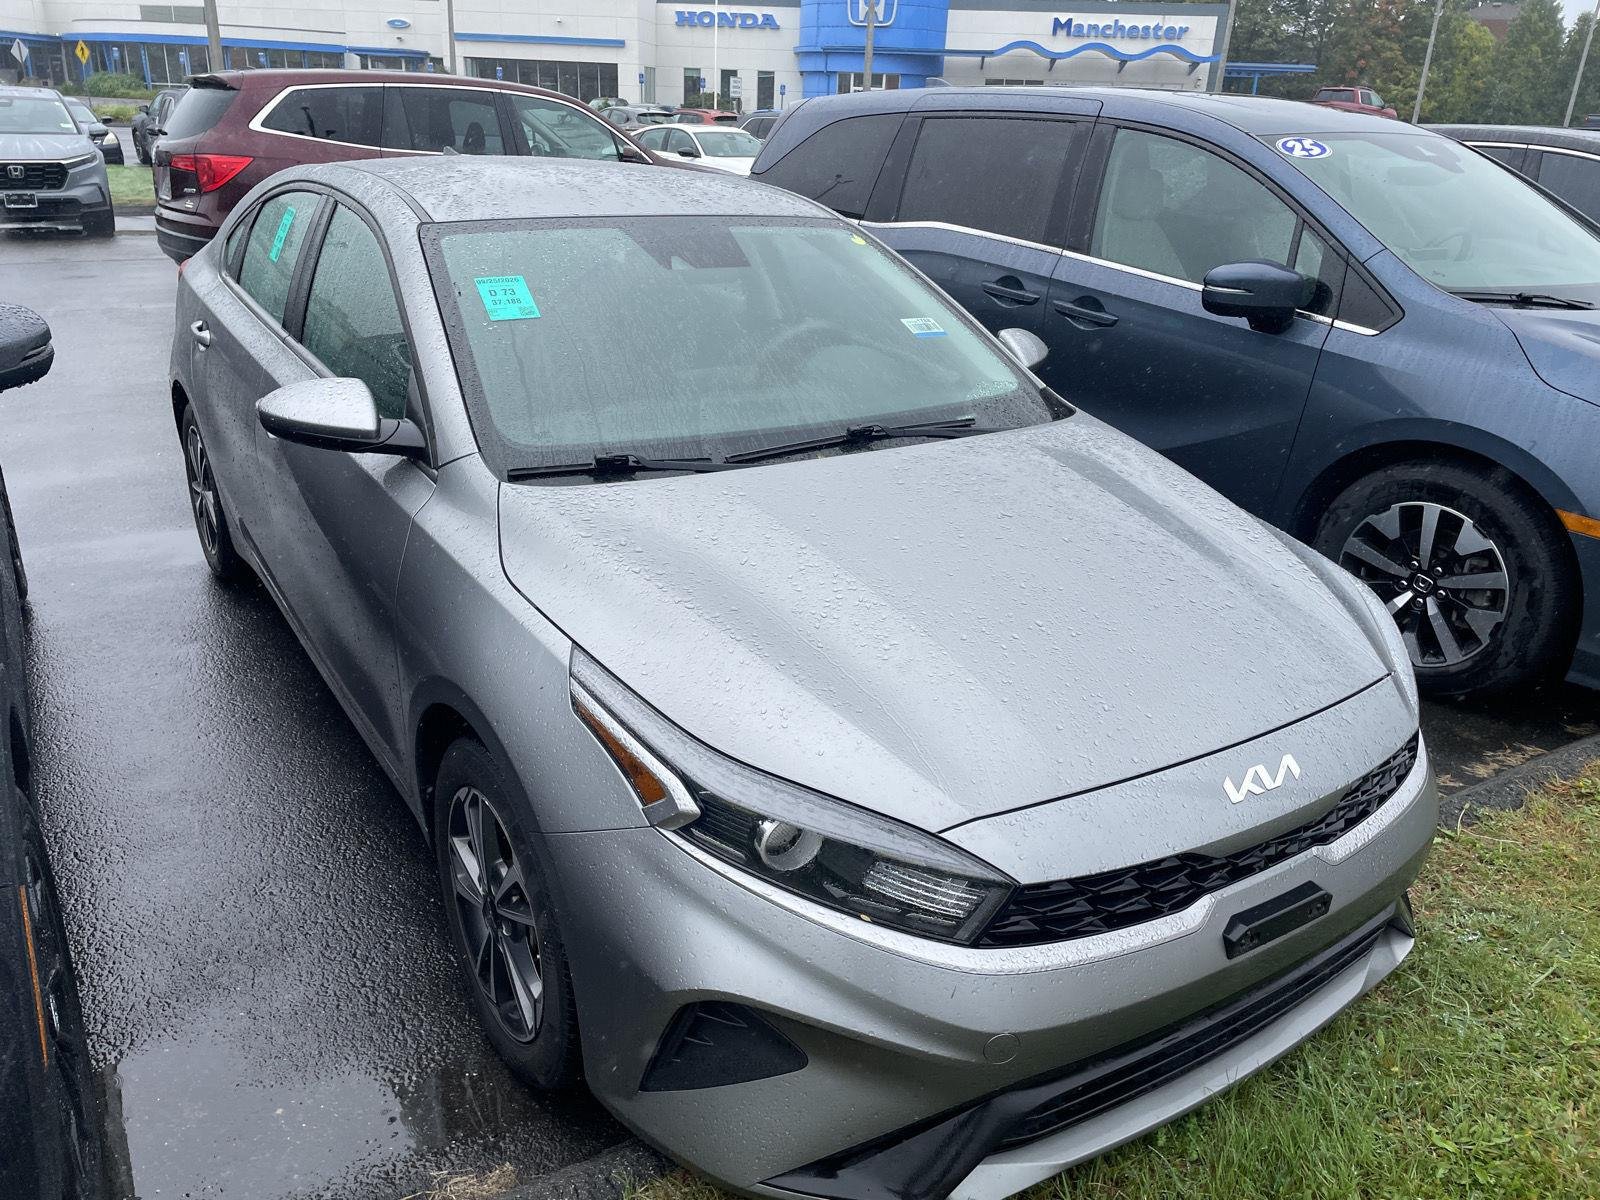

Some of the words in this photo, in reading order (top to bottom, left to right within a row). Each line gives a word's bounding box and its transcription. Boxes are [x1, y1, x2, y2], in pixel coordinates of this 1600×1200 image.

[675, 10, 781, 29] HONDA
[1052, 17, 1190, 40] Manchester
[1286, 138, 1322, 156] 25
[489, 289, 498, 297] D
[501, 288, 516, 296] 73
[1222, 753, 1301, 805] KIA
